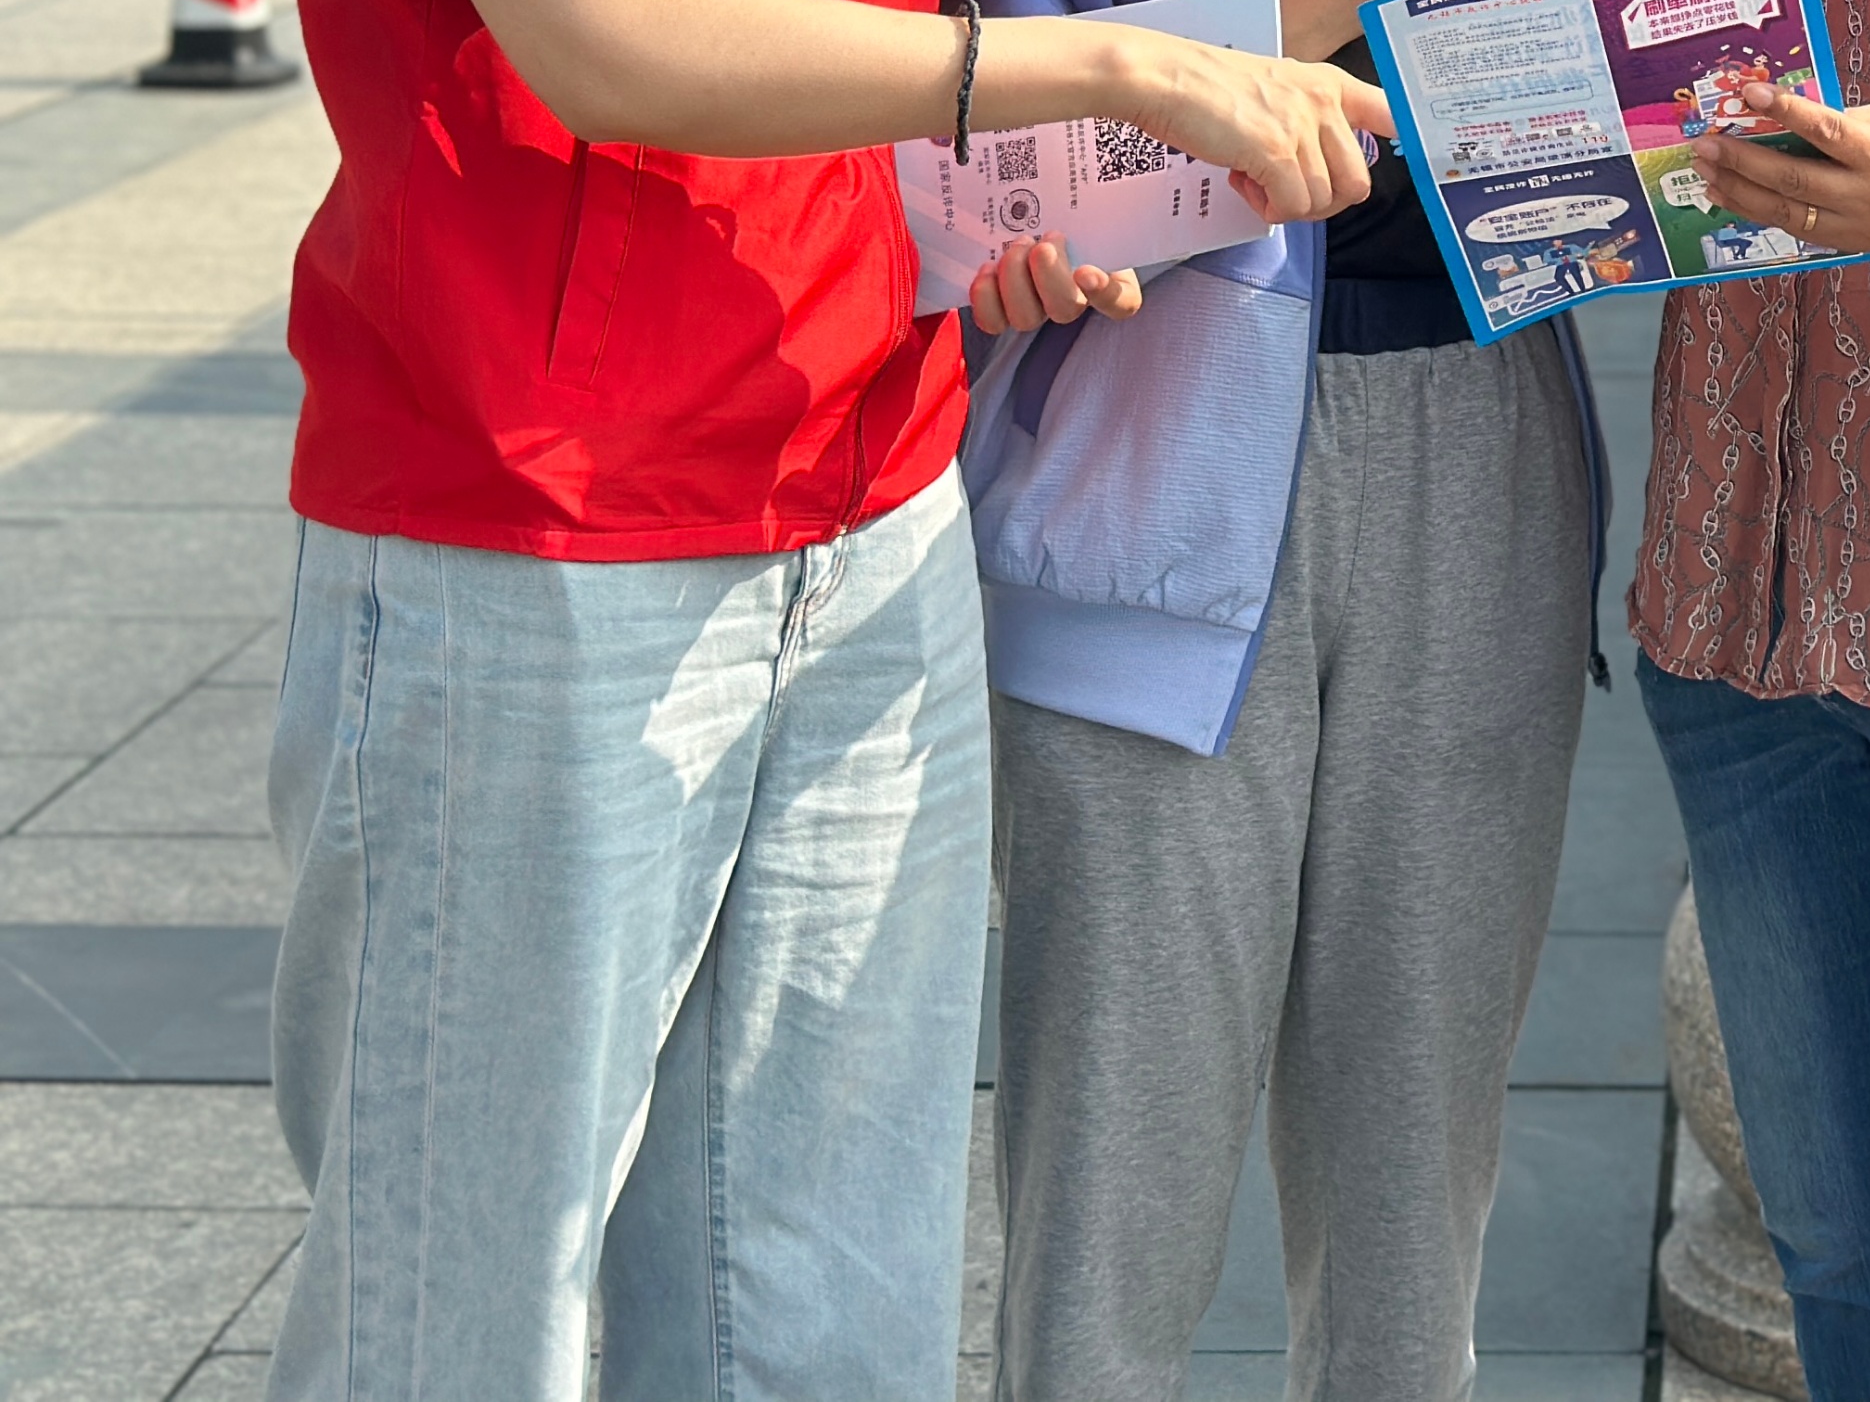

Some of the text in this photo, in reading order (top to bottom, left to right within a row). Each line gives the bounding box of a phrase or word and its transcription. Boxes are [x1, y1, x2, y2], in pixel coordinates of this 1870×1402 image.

[1648, 0, 1736, 28] 本来想挣点零花钱
[1651, 11, 1739, 40] 结果失去了压岁钱
[938, 160, 955, 231] 国家反诈中心
